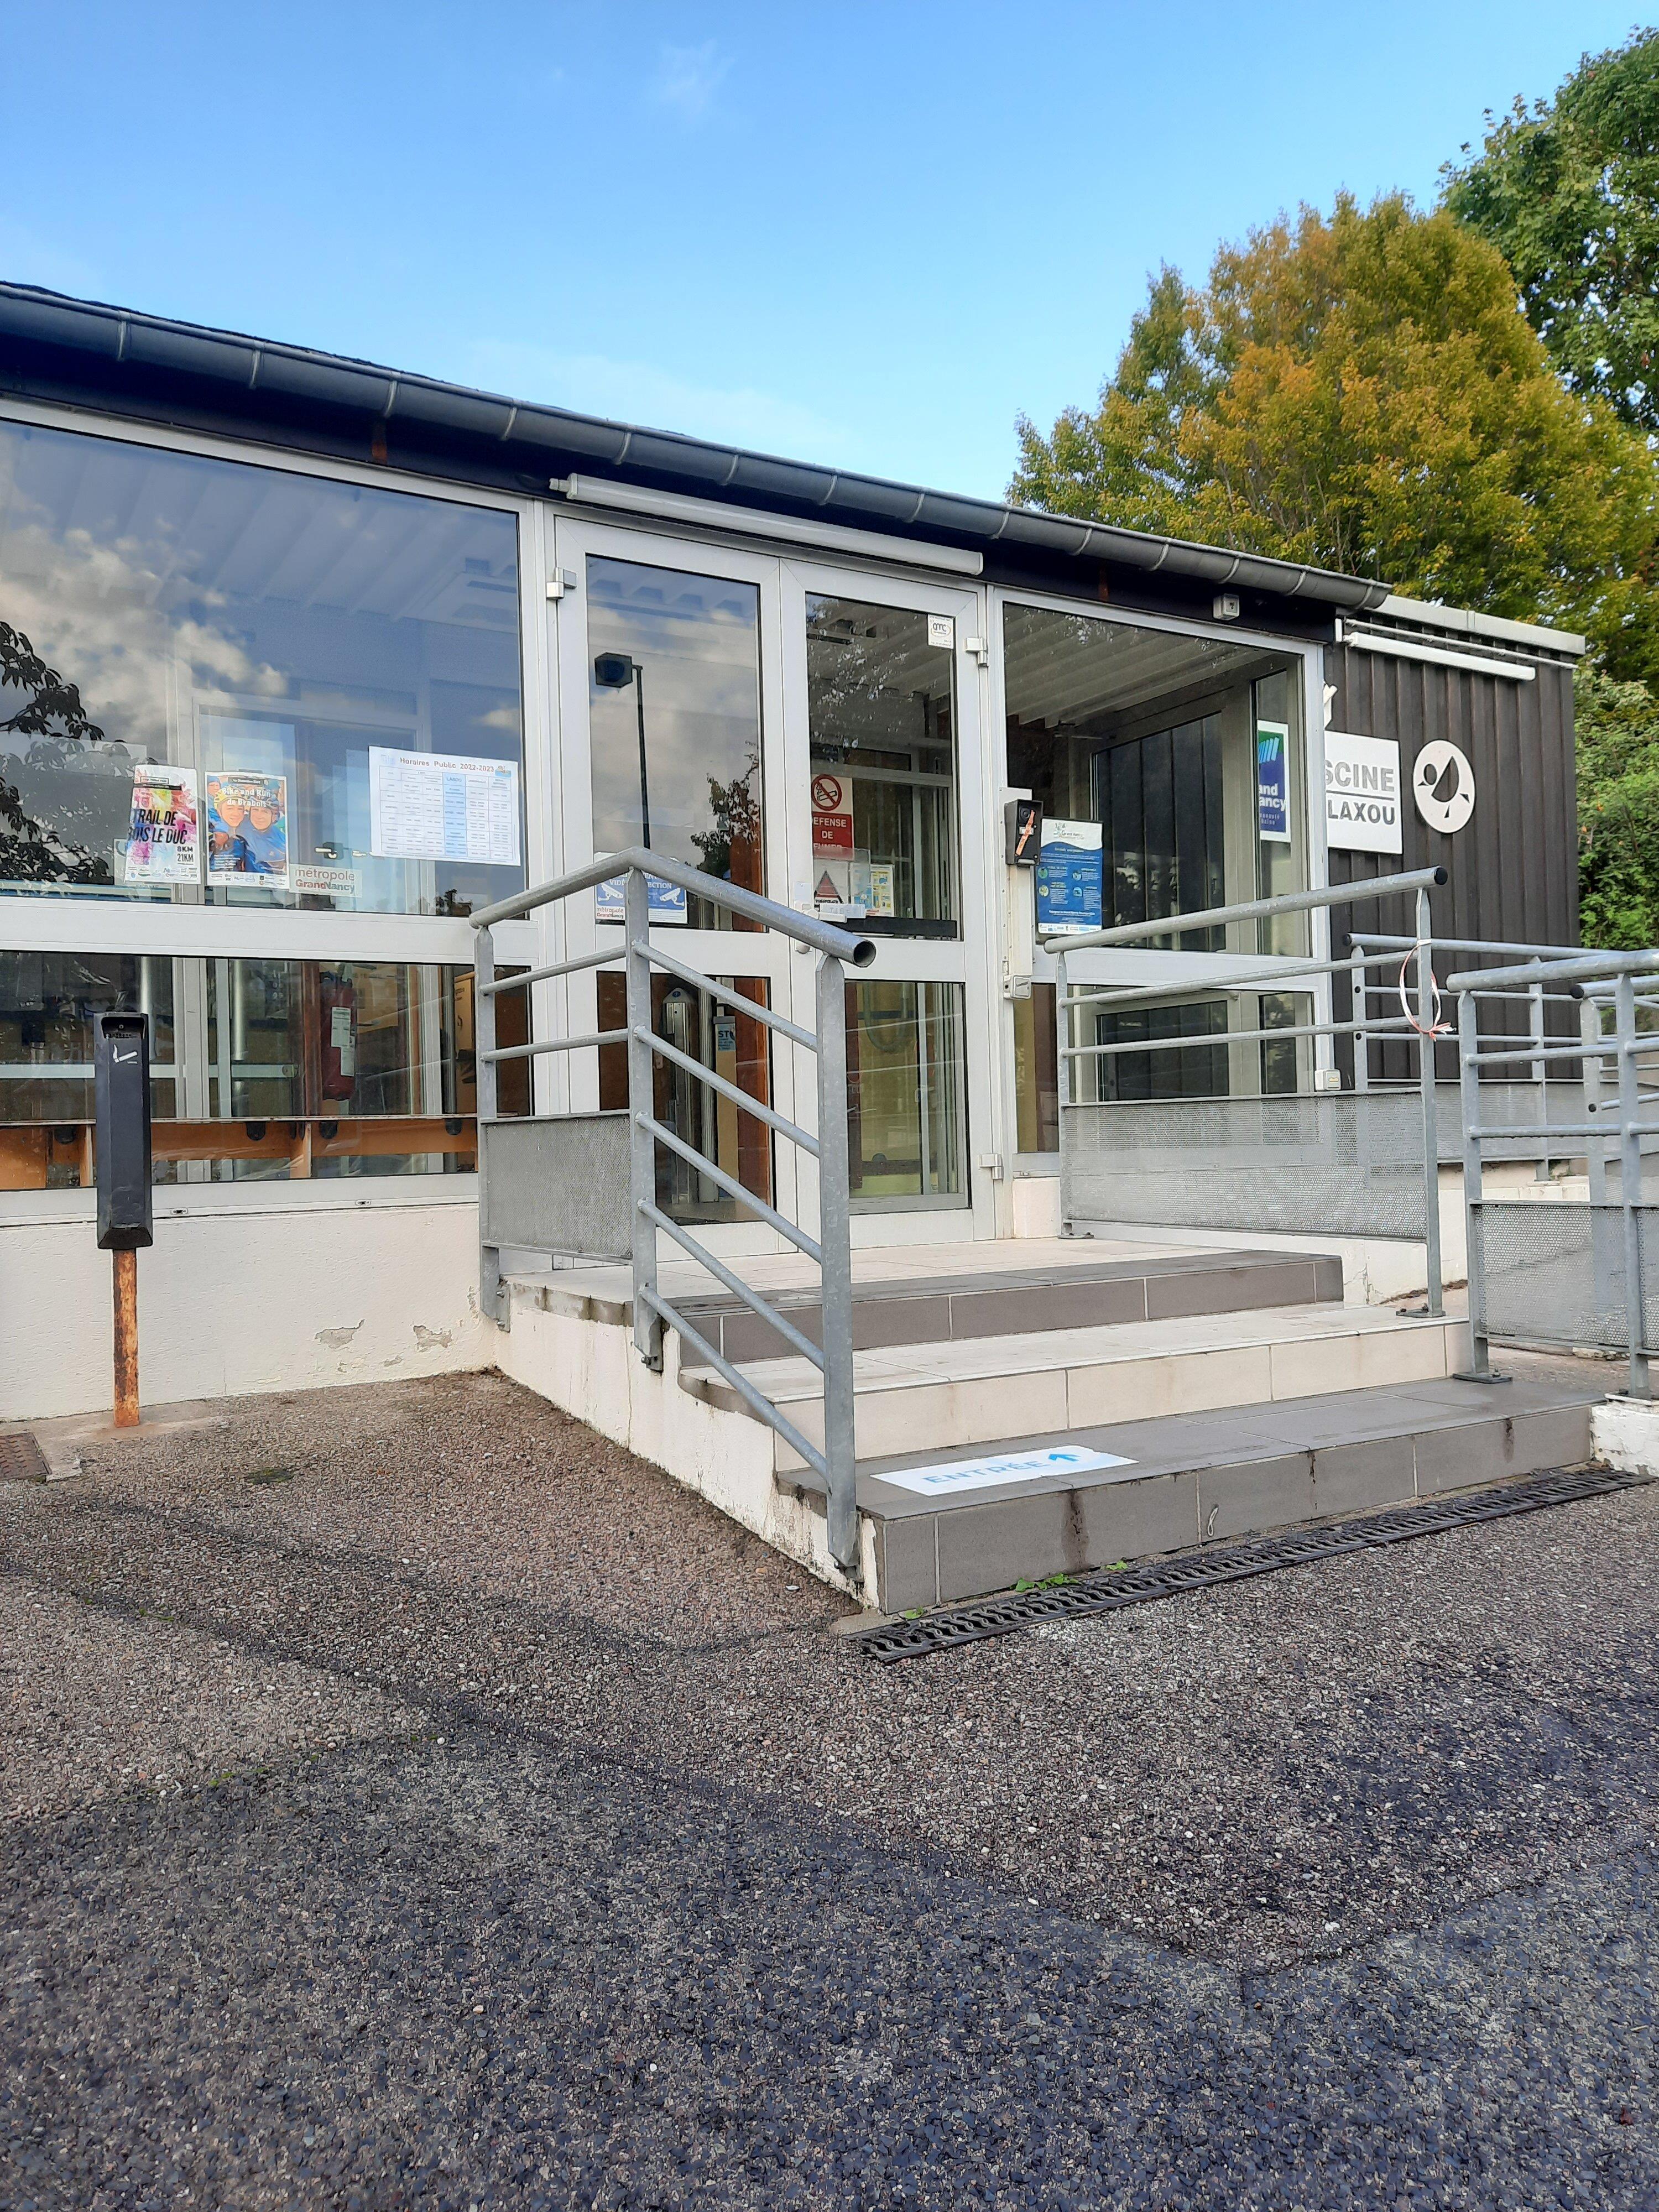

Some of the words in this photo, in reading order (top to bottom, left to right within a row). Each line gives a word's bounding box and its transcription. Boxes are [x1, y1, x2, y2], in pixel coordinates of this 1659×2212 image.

[400, 757, 430, 766] Horaires
[434, 760, 456, 769] Public
[460, 763, 494, 773] 2022-2023
[1325, 759, 1395, 792] SCINE
[1259, 782, 1279, 796] and
[1259, 796, 1286, 811] ancy
[133, 808, 162, 825] TRAIL
[163, 810, 178, 827] DE
[1327, 799, 1395, 826] LAXOU
[813, 816, 847, 828] EFENSE
[152, 827, 165, 843] LE
[165, 824, 187, 844] DUC
[821, 830, 834, 839] DE
[177, 853, 194, 863] 21KM
[295, 867, 355, 881] métropole
[922, 1460, 1051, 1484] ENTRÉE
